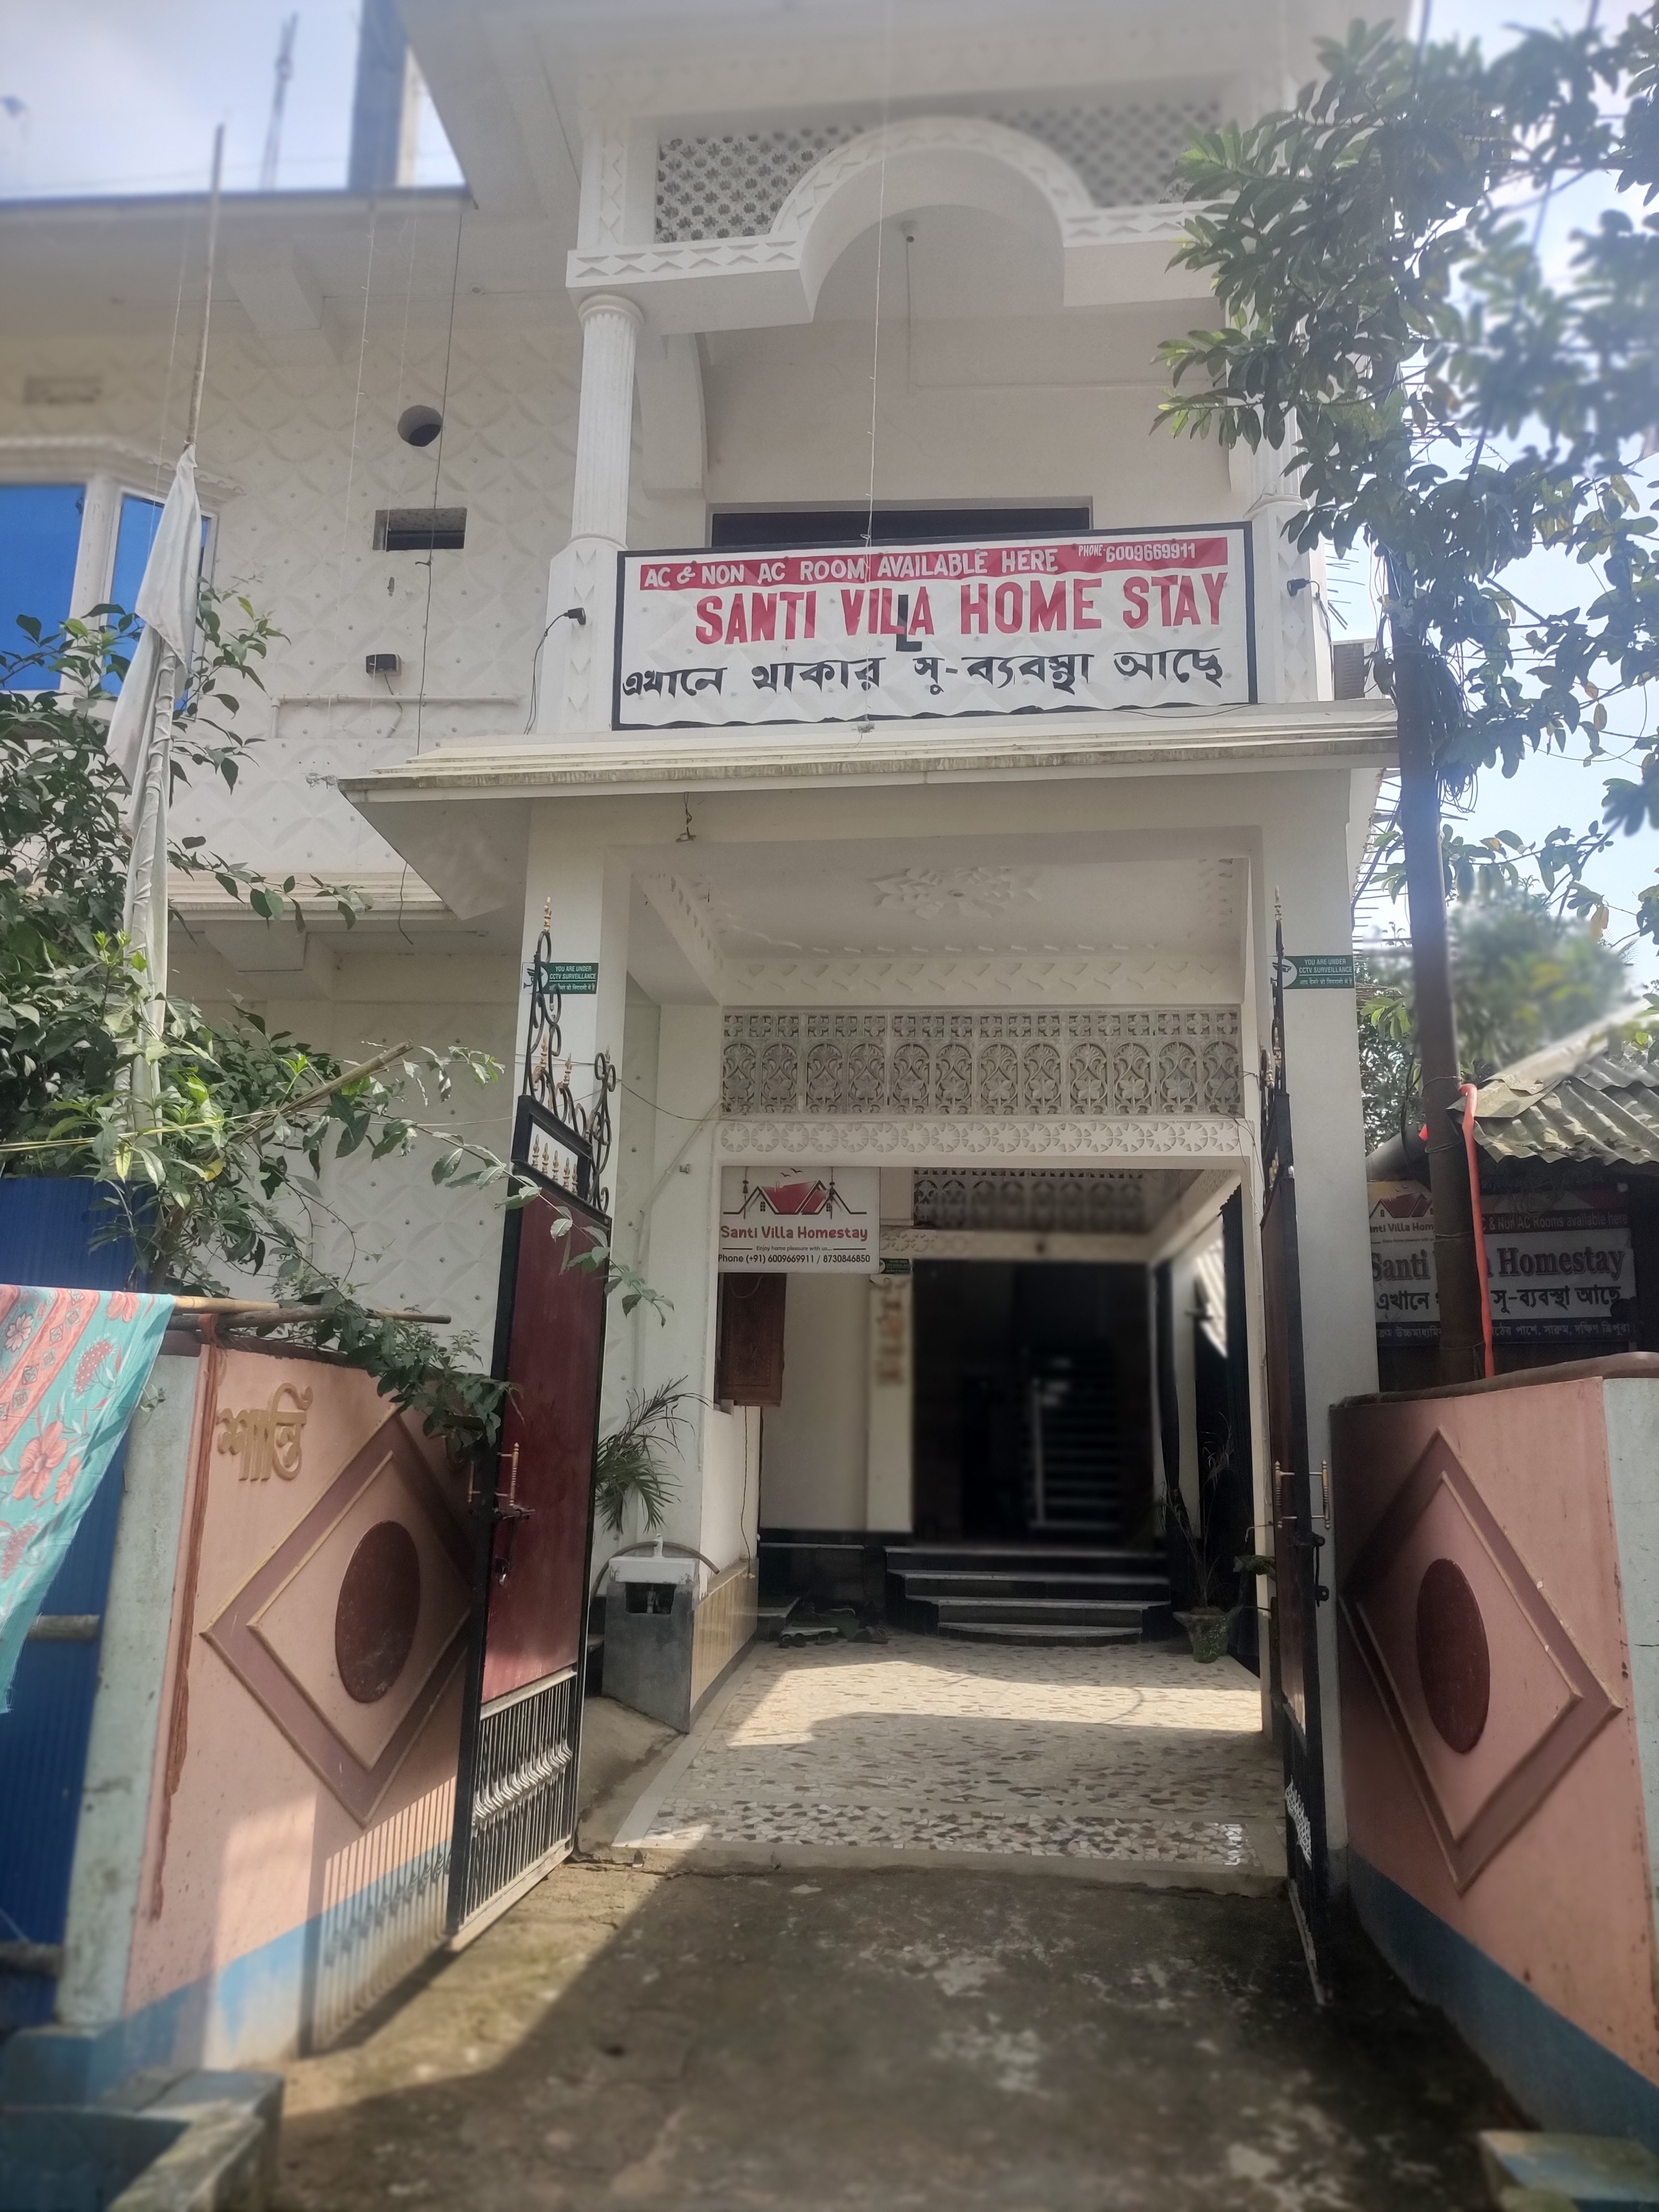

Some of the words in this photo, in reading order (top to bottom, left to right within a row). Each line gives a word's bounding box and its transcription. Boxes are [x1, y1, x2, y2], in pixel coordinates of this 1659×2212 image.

[644, 567, 671, 587] AC
[676, 566, 696, 585] &
[702, 564, 744, 585] NON
[758, 562, 786, 585] AC
[800, 558, 865, 581] ROOM
[877, 551, 988, 578] AVAILABLE
[1002, 549, 1058, 573] HERE
[695, 590, 817, 645] SANTI
[841, 586, 934, 651] VILLA
[961, 578, 1102, 635] HOME
[1123, 572, 1228, 629] STAY
[623, 667, 728, 698] এখানে
[752, 657, 886, 693] থাকার
[1114, 648, 1223, 688] আছে
[1387, 1223, 1410, 1232] Villa
[1518, 1216, 1530, 1229] AC
[1533, 1217, 1564, 1228] Rooms
[1567, 1212, 1606, 1227] available
[1608, 1212, 1628, 1224] here
[720, 1225, 758, 1239] Santi
[761, 1226, 794, 1239] Villa
[797, 1226, 868, 1241] Homestay
[718, 1254, 744, 1262] Phone
[746, 1254, 766, 1264] (+91)
[768, 1254, 814, 1262] 6009669911
[817, 1255, 820, 1264] /
[823, 1254, 870, 1262] 8730846850
[1371, 1249, 1431, 1281] Santi
[1497, 1246, 1625, 1281] Homestay
[1376, 1290, 1430, 1310] এখানে
